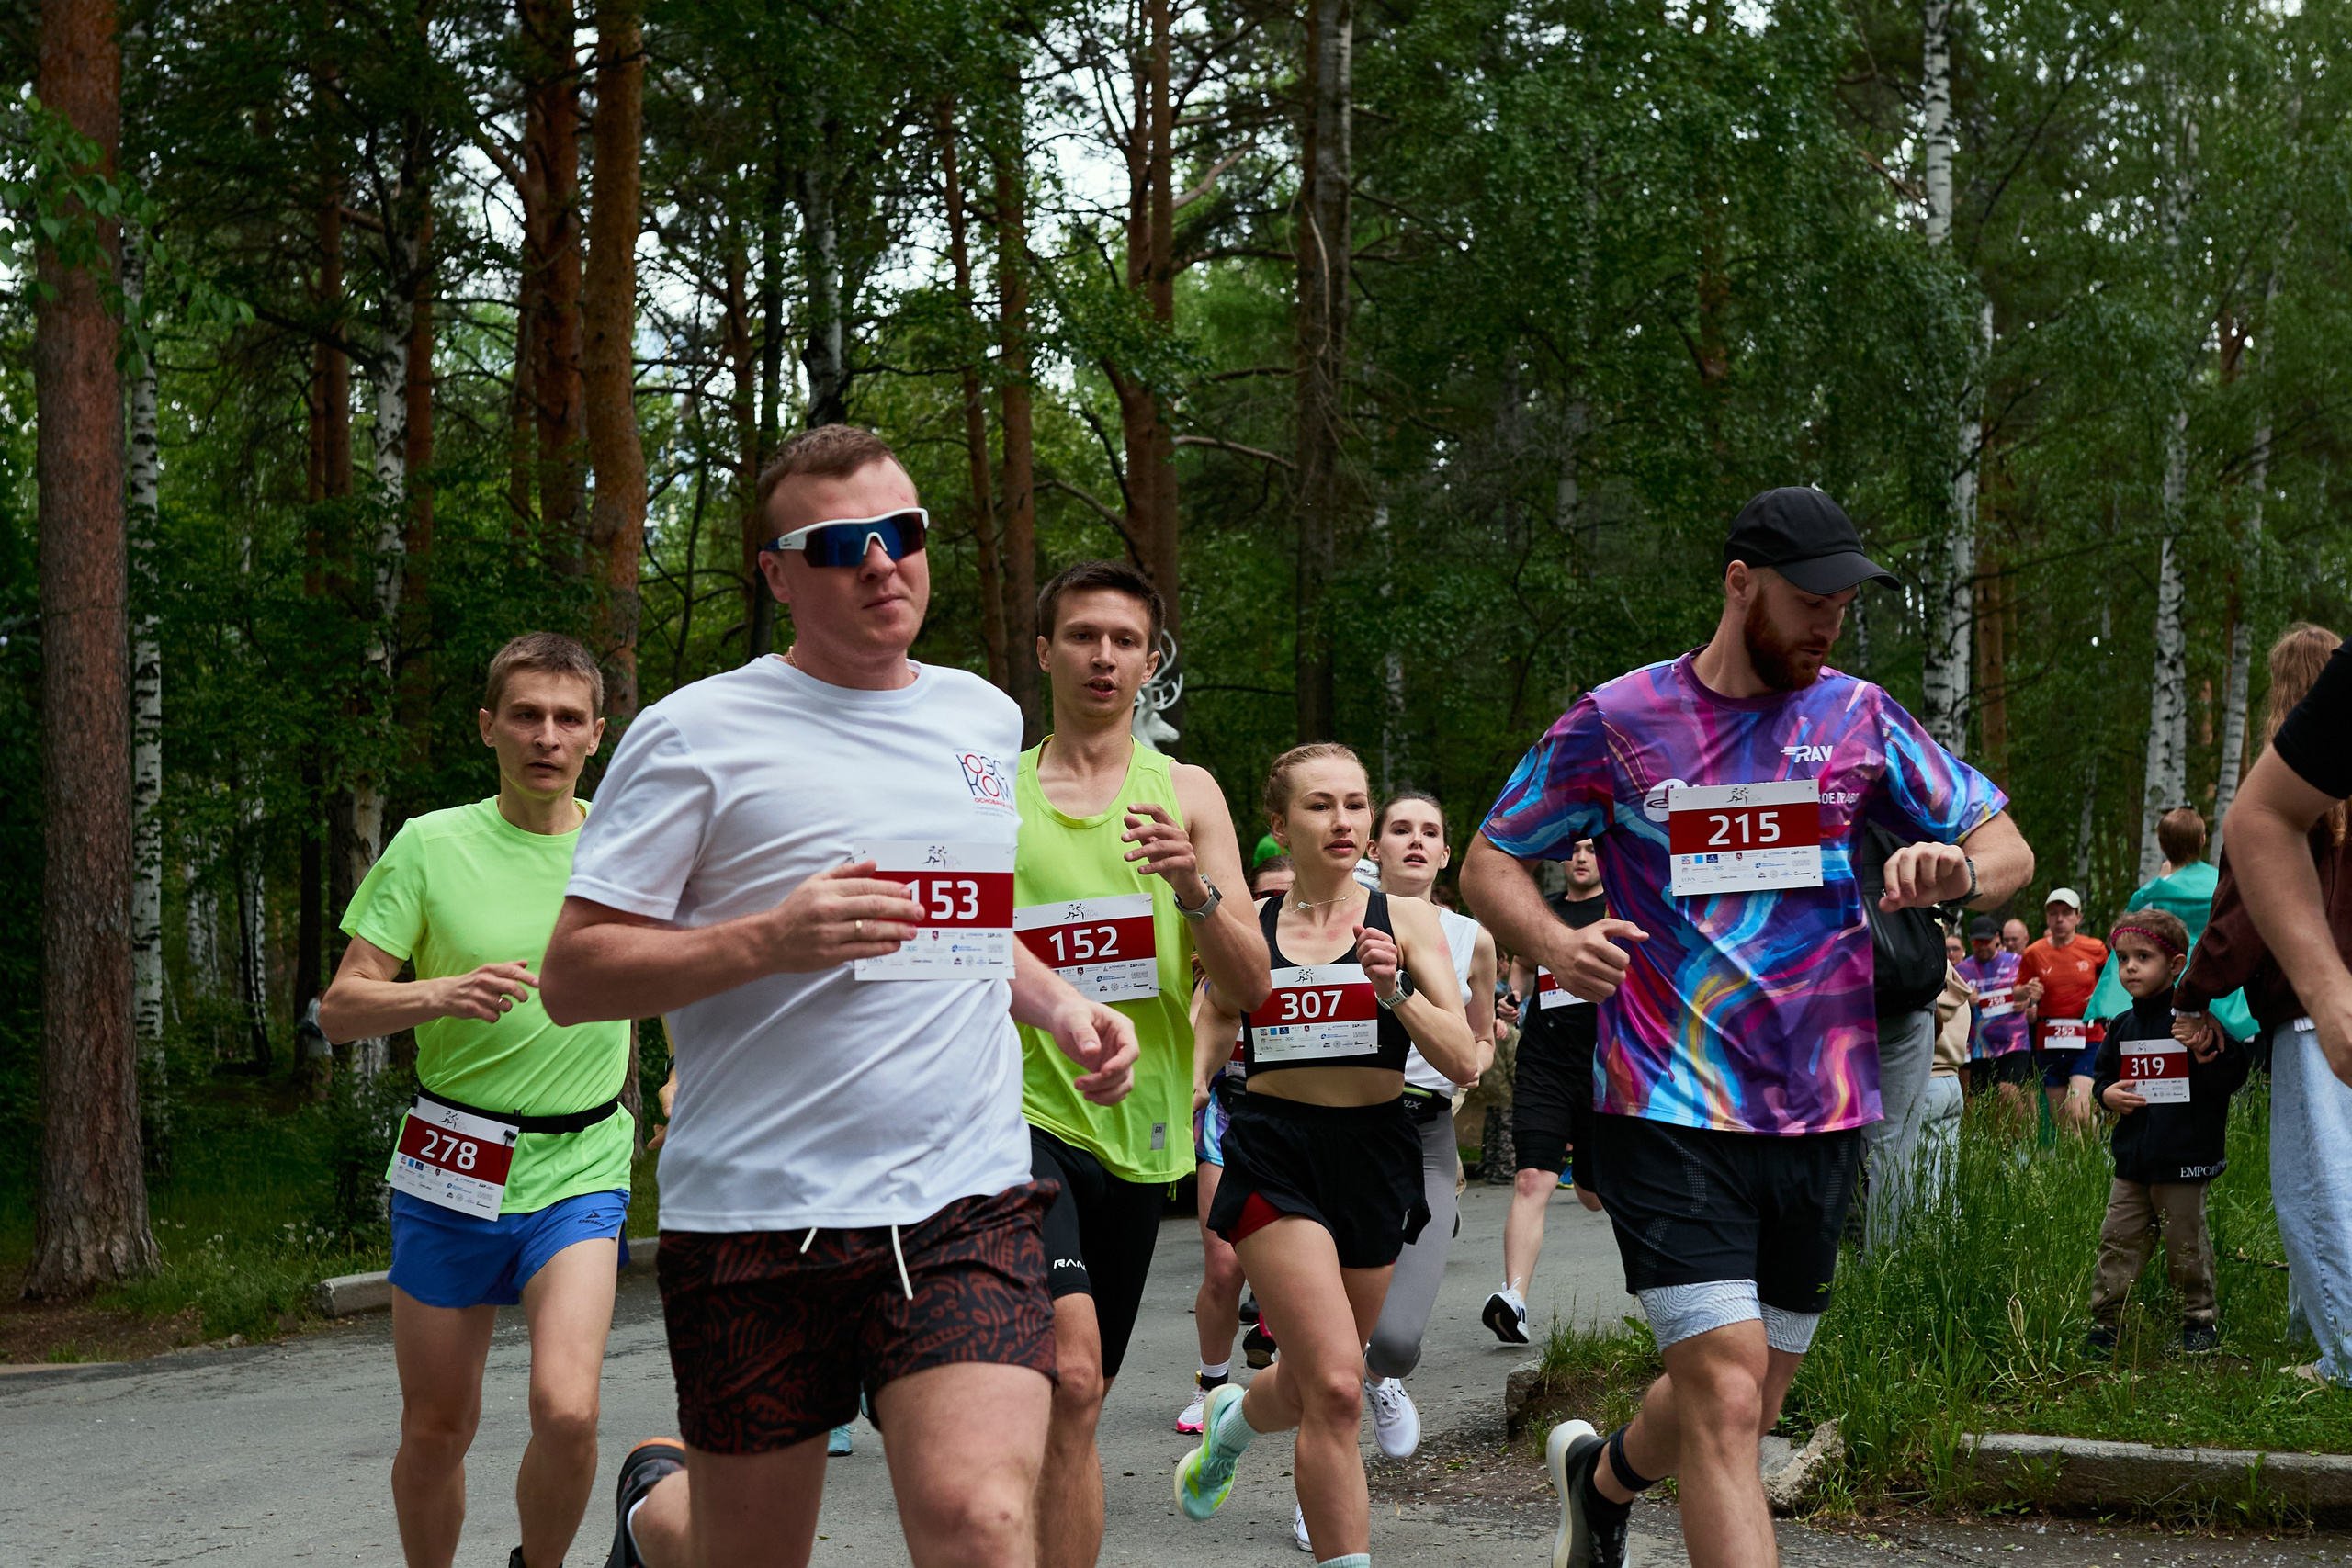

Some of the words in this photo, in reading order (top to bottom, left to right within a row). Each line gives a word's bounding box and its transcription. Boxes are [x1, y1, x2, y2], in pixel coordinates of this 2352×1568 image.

[1786, 745, 1834, 763] RAY
[1707, 811, 1781, 846] 215
[906, 879, 979, 920] 153
[1048, 926, 1120, 962] 152
[1280, 989, 1343, 1021] 307
[2131, 1056, 2165, 1077] 319
[420, 1129, 479, 1170] 278
